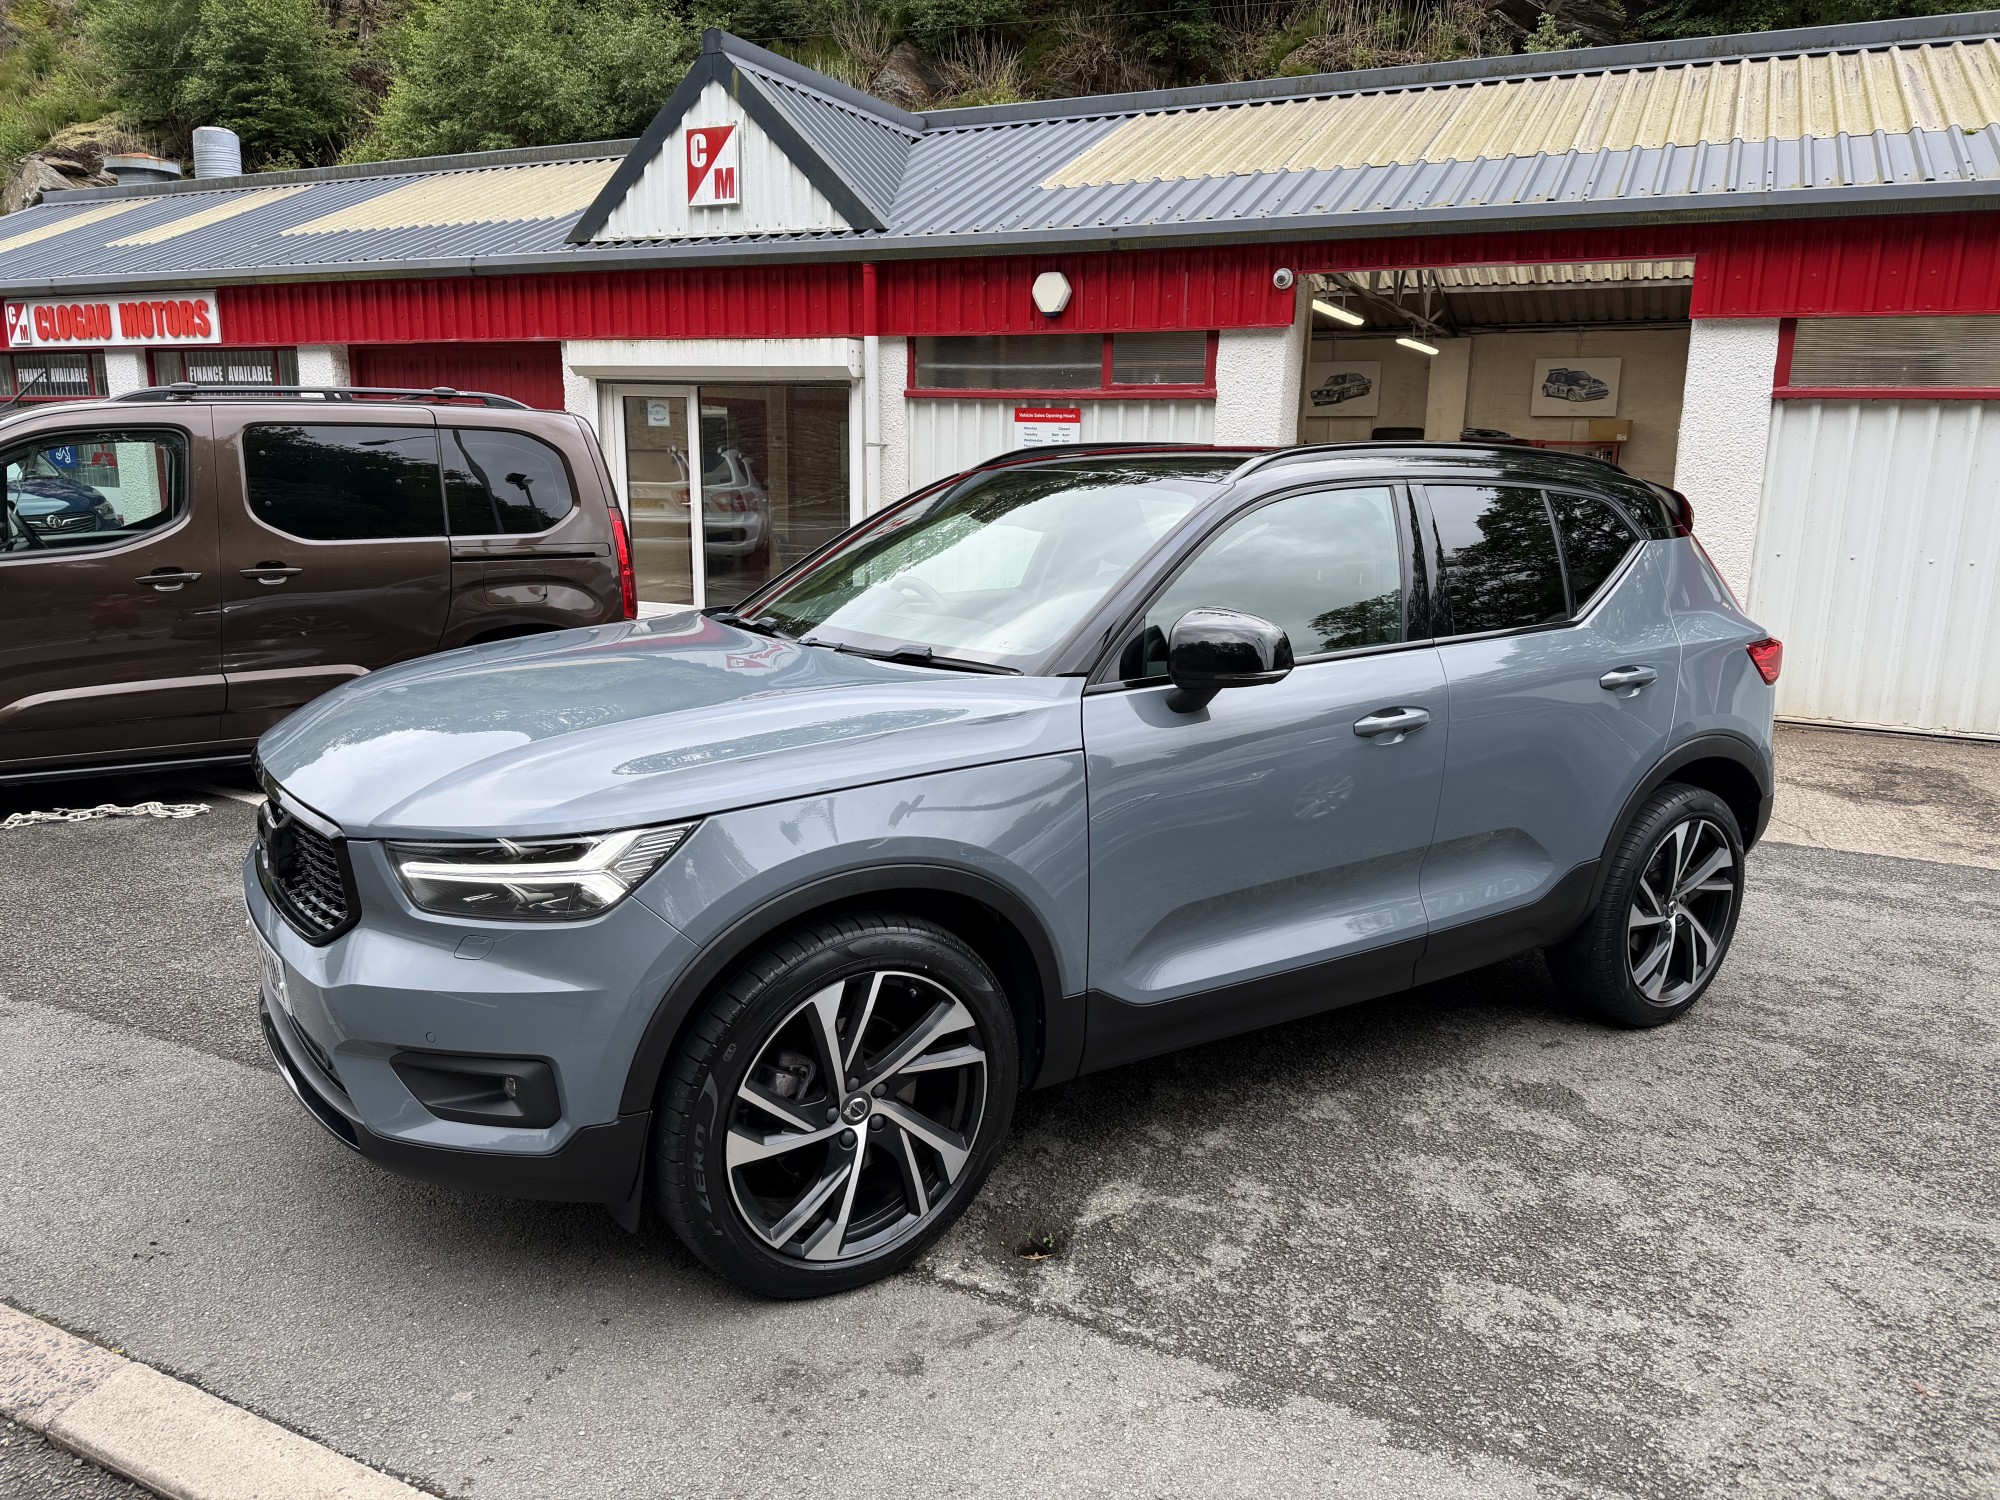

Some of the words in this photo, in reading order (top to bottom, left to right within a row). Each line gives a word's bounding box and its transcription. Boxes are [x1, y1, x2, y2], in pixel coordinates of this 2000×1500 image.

[690, 133, 707, 168] C
[714, 167, 735, 199] M
[8, 305, 17, 325] C
[33, 303, 112, 341] CLOGAU
[118, 299, 211, 339] MOTORS
[20, 324, 29, 341] M
[18, 367, 48, 383] FINANCE
[50, 367, 88, 383] AVAILABLE
[189, 366, 223, 382] FINANCE
[228, 365, 273, 381] AVAILABLE
